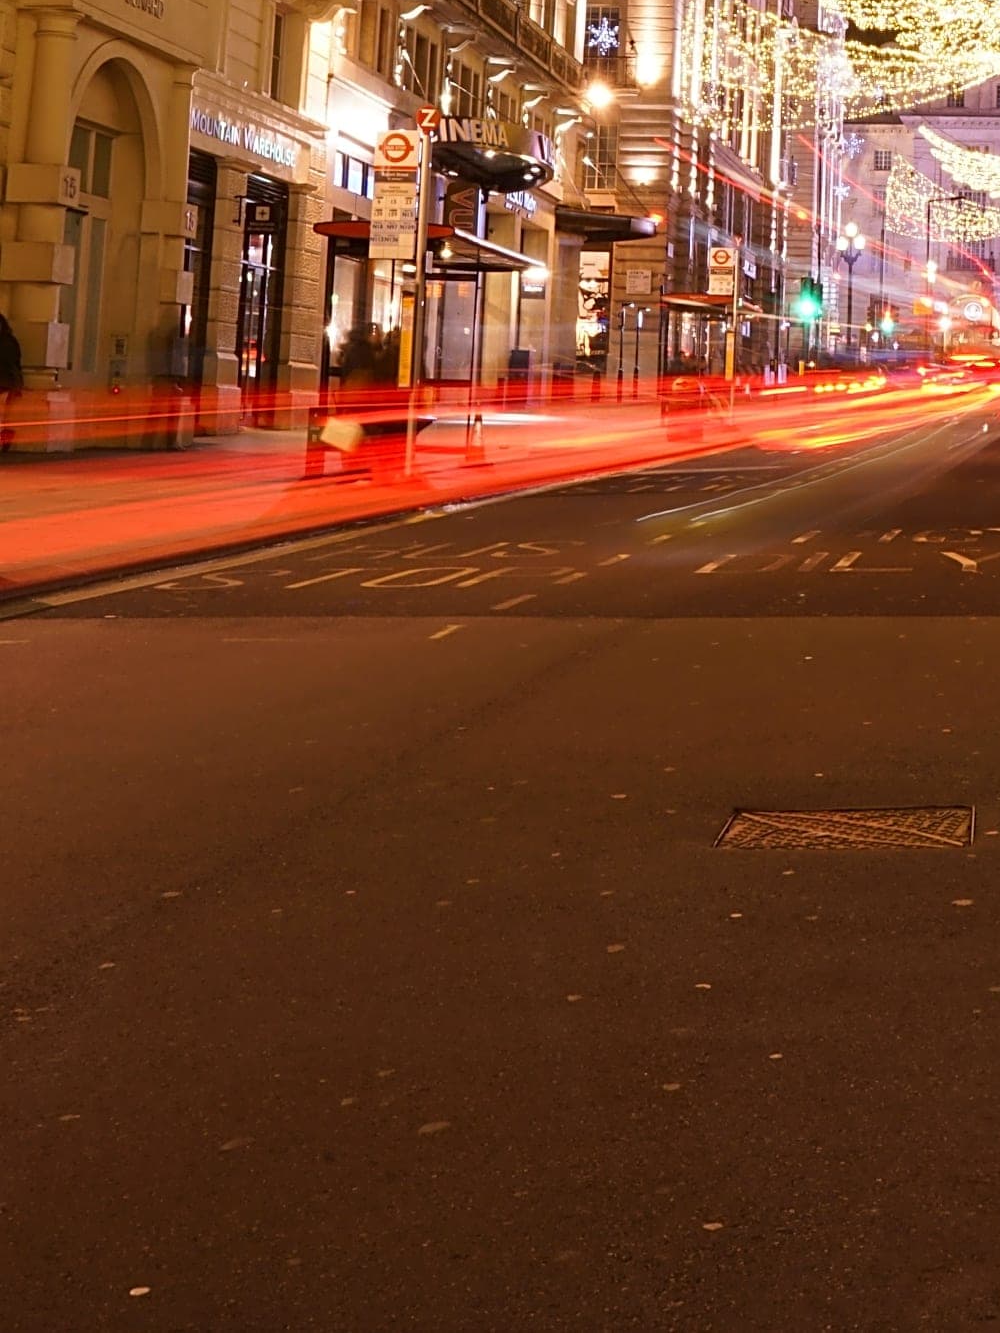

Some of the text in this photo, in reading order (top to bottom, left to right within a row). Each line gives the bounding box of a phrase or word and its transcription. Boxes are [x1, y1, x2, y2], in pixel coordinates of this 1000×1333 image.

[421, 109, 436, 127] Z
[430, 118, 508, 147] INEMA
[152, 566, 578, 590] STOP
